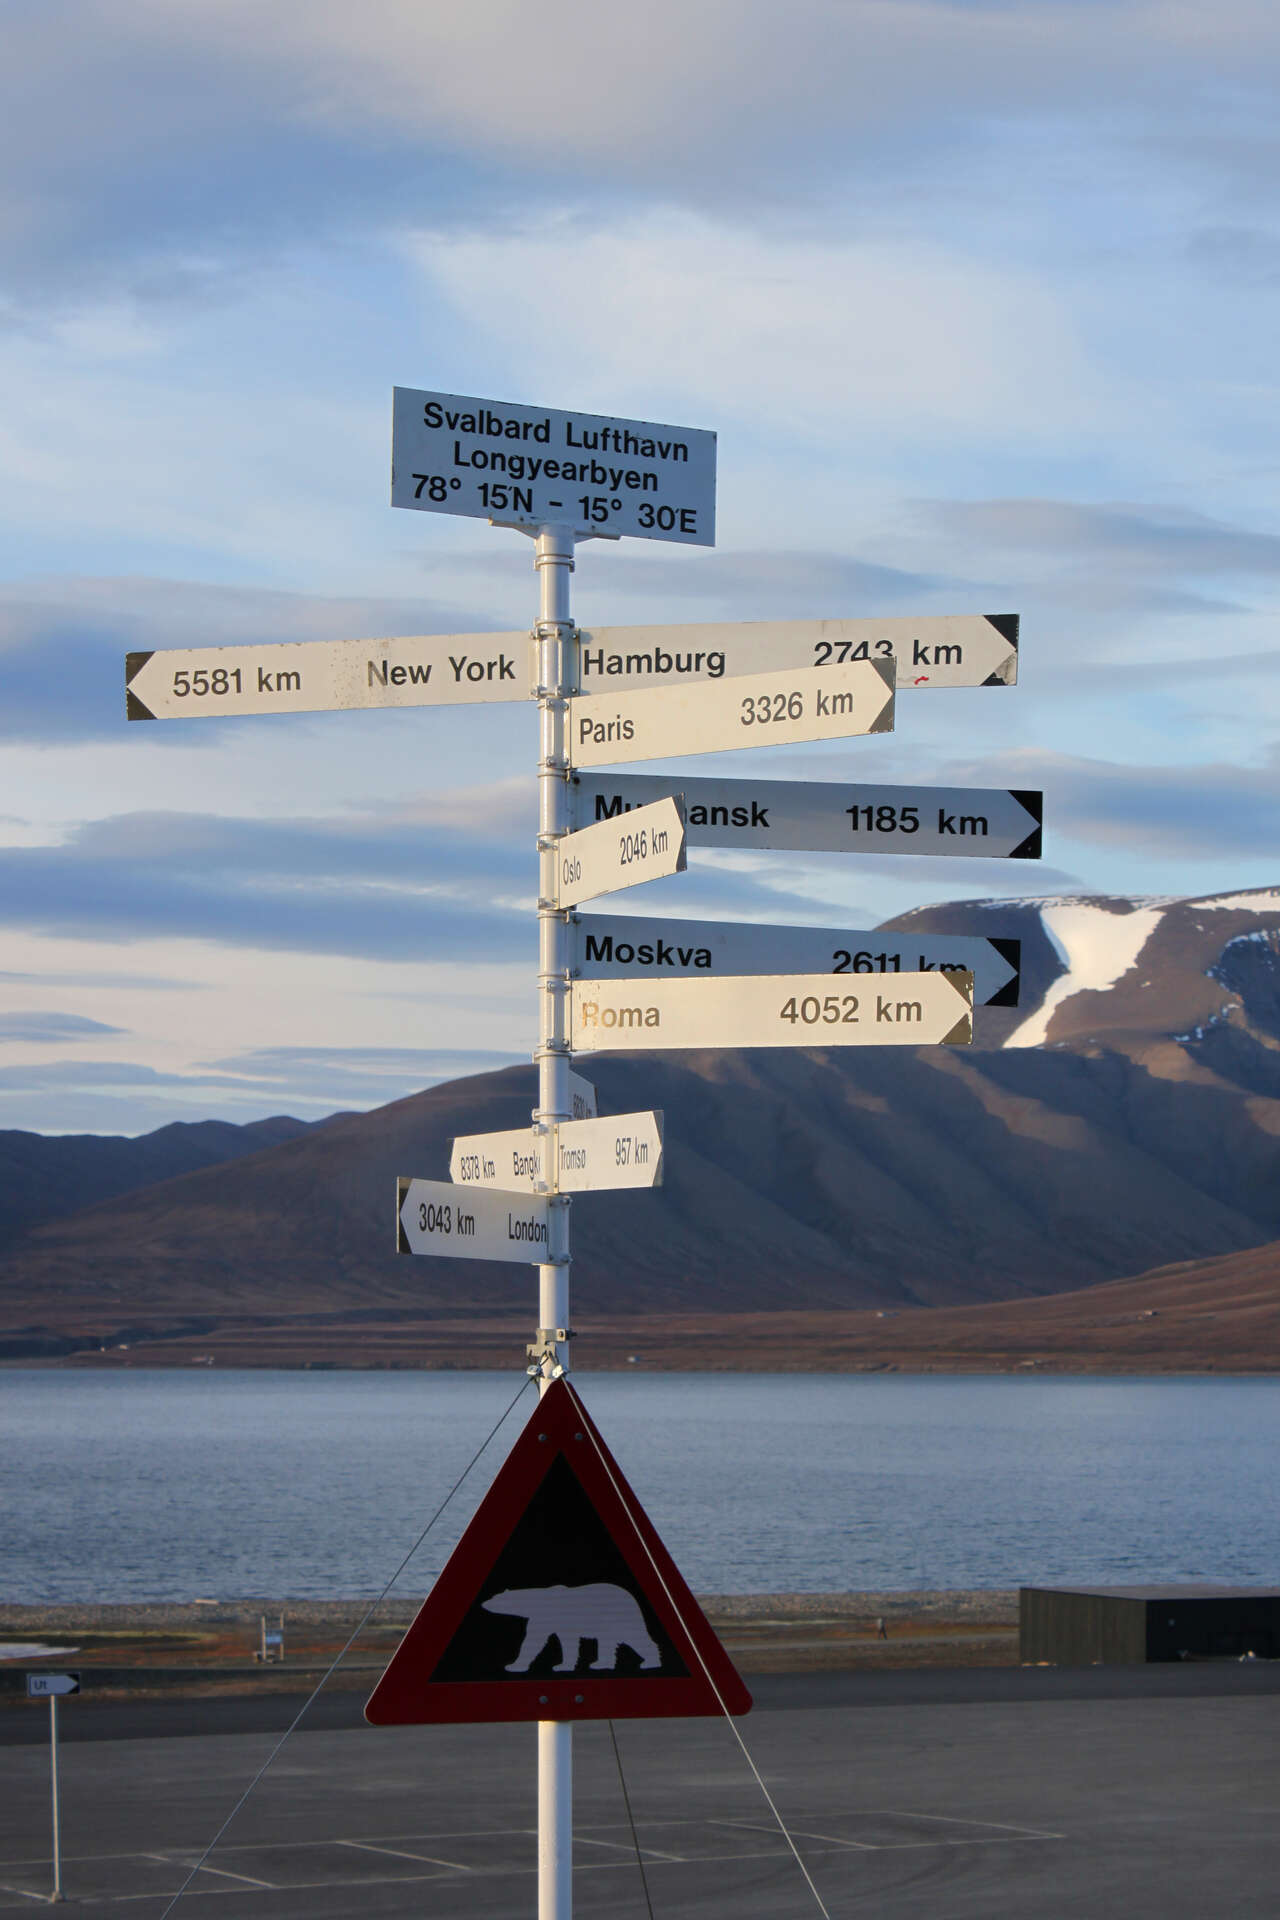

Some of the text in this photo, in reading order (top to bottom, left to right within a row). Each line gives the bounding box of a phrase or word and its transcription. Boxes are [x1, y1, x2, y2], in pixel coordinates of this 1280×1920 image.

[424, 402, 689, 462] Svalbard Lufthavn
[454, 441, 658, 491] Longyearbyen
[173, 654, 516, 698] 5581 km New York
[584, 639, 963, 679] Hamburg 2743 km
[579, 689, 854, 745] Paris 3326 km
[594, 794, 989, 836] Mansk 1185 km
[620, 826, 669, 866] 2046 km
[562, 861, 582, 886] Oslo
[585, 935, 712, 969] Moskva
[832, 950, 901, 974] 2611
[582, 996, 923, 1028] Roma 4052 km
[460, 1155, 481, 1181] 8378
[483, 1153, 496, 1179] km
[615, 1138, 632, 1166] 957
[634, 1136, 649, 1164] km
[418, 1203, 547, 1244] 3043 km London
